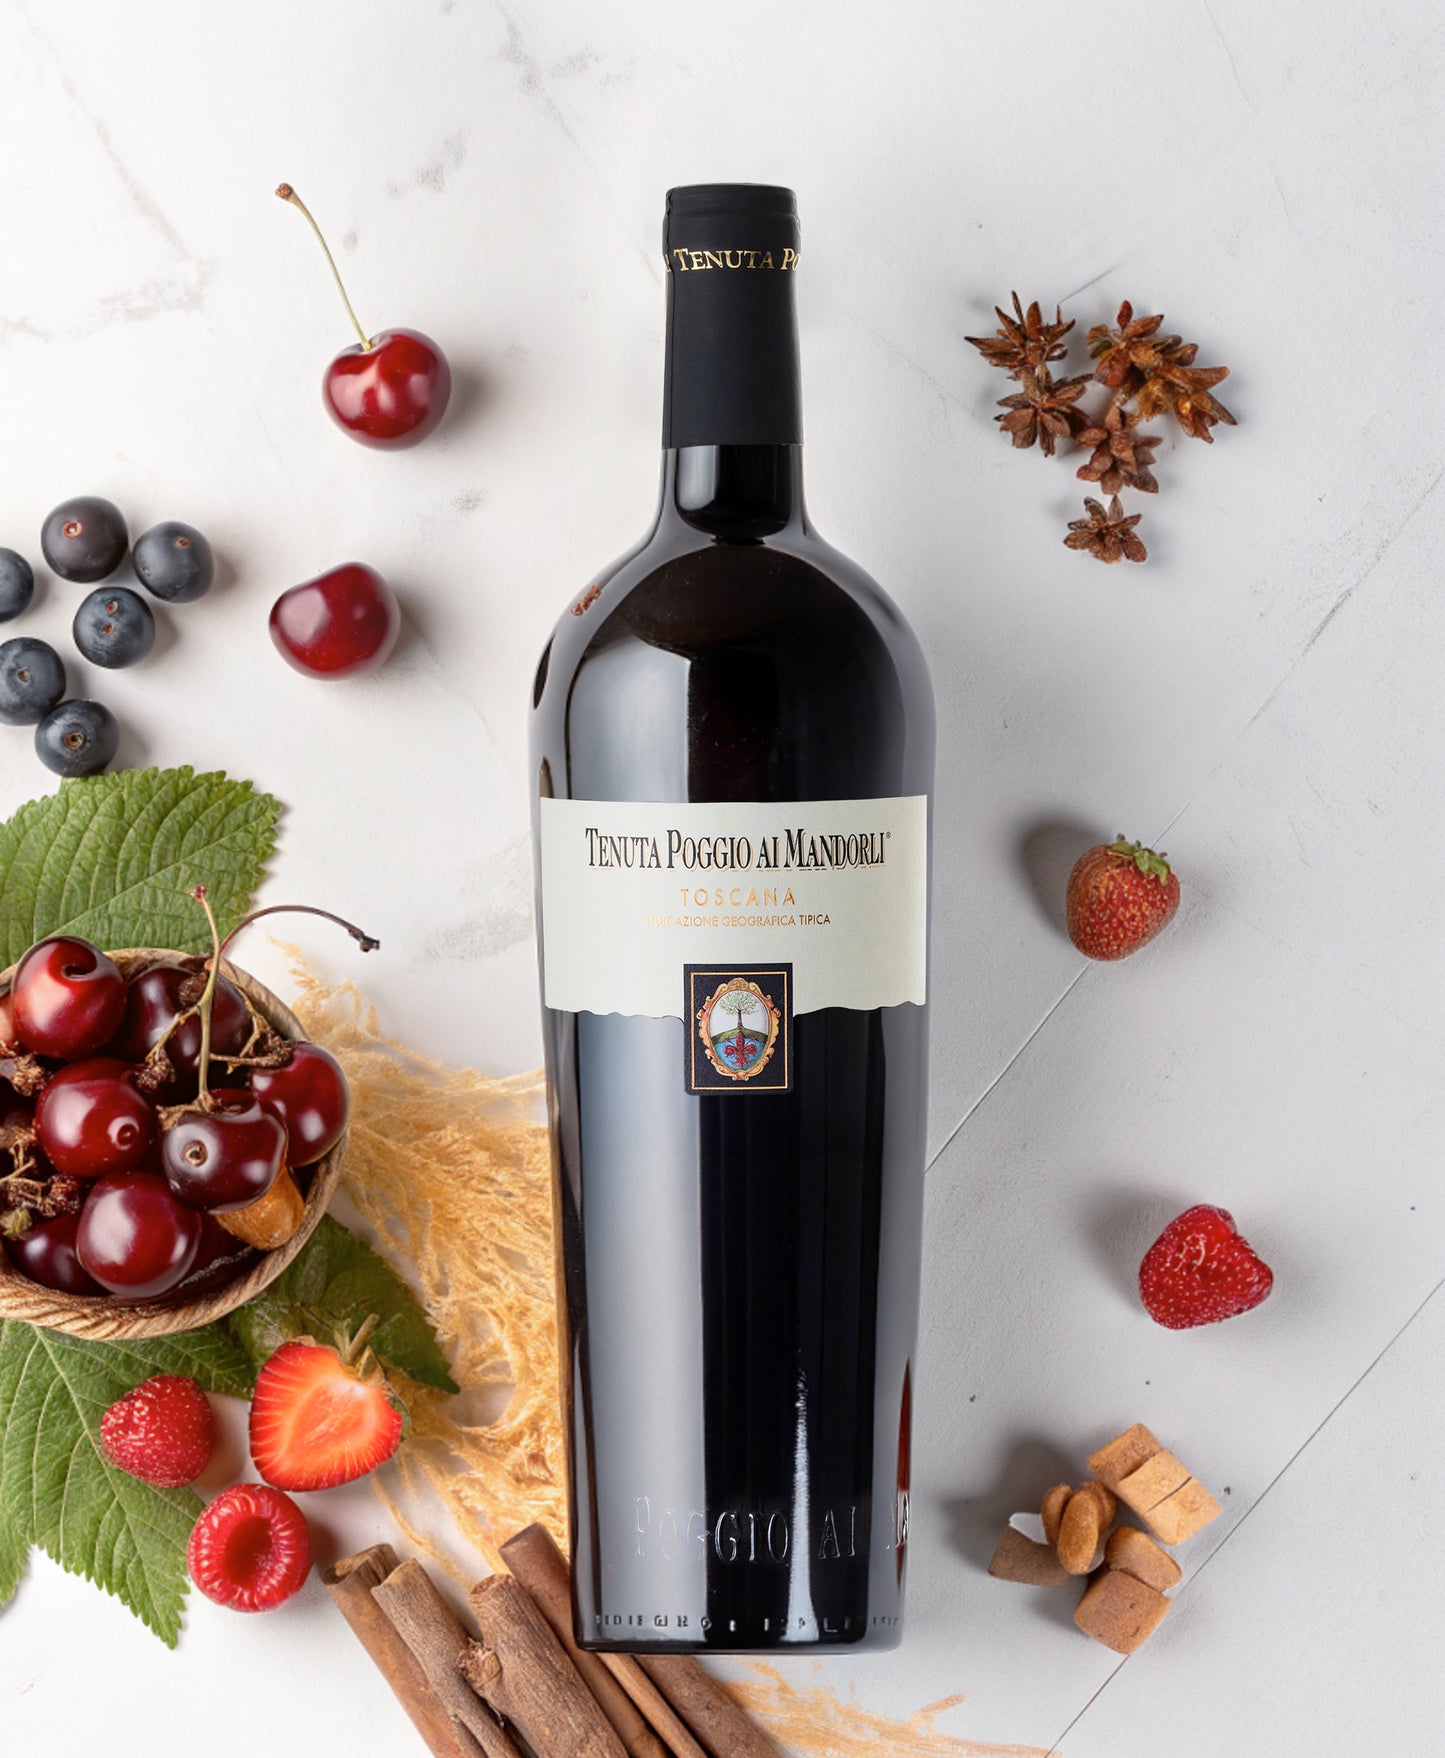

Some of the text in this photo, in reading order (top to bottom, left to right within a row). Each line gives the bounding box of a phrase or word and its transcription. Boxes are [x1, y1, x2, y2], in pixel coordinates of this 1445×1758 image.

[673, 248, 775, 271] TENUTA
[585, 828, 662, 868] TENUTA
[666, 829, 751, 869] POGGIO
[756, 836, 780, 868] AI
[680, 888, 796, 907] TOSCANA
[644, 914, 831, 927] NDICAZIONE GEOGRAFICA TIPICA
[634, 1495, 789, 1563] POGGIO
[818, 1506, 856, 1559] AI
